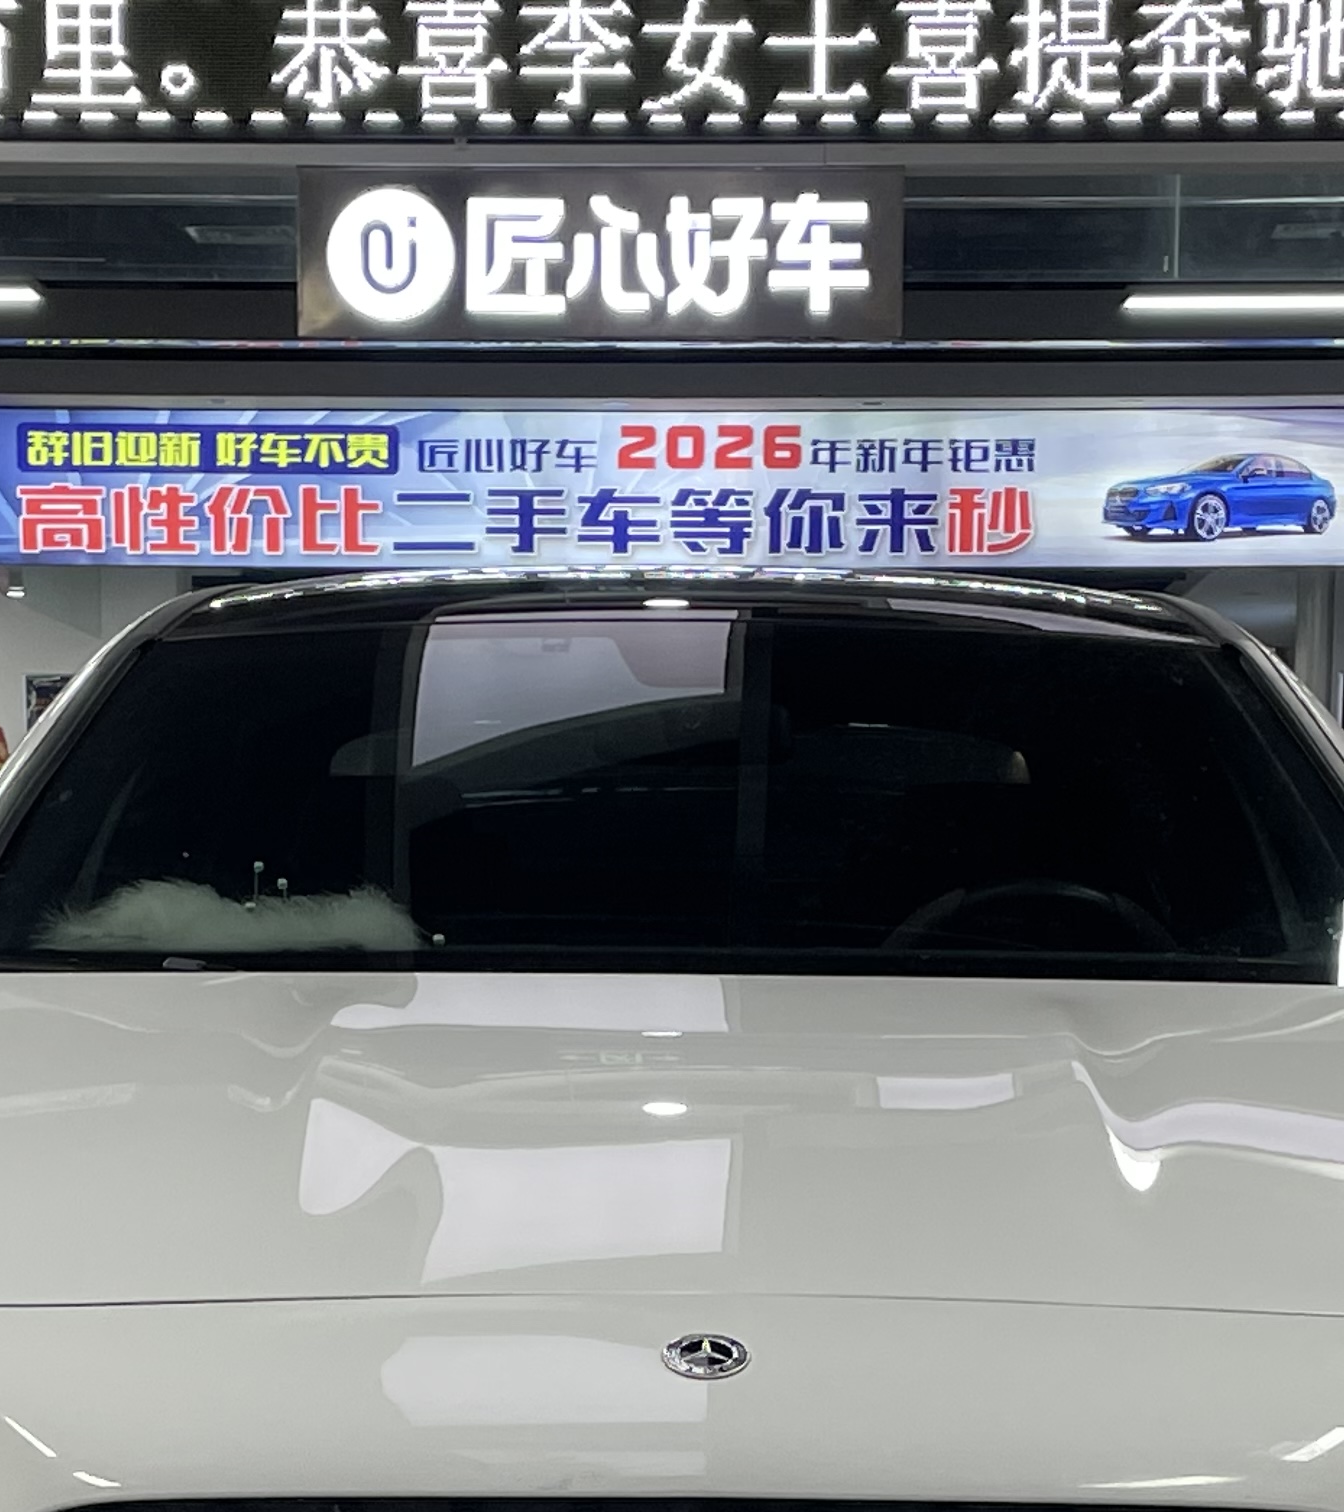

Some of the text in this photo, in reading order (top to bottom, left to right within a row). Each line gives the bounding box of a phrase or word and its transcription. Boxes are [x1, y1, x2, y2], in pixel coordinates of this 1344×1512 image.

[465, 192, 871, 316] 匠心好车
[27, 431, 390, 469] 辞旧迎新 好车不贵
[417, 437, 598, 474] 匠心好车
[17, 483, 1035, 557] 高性价比二手车等你来秒
